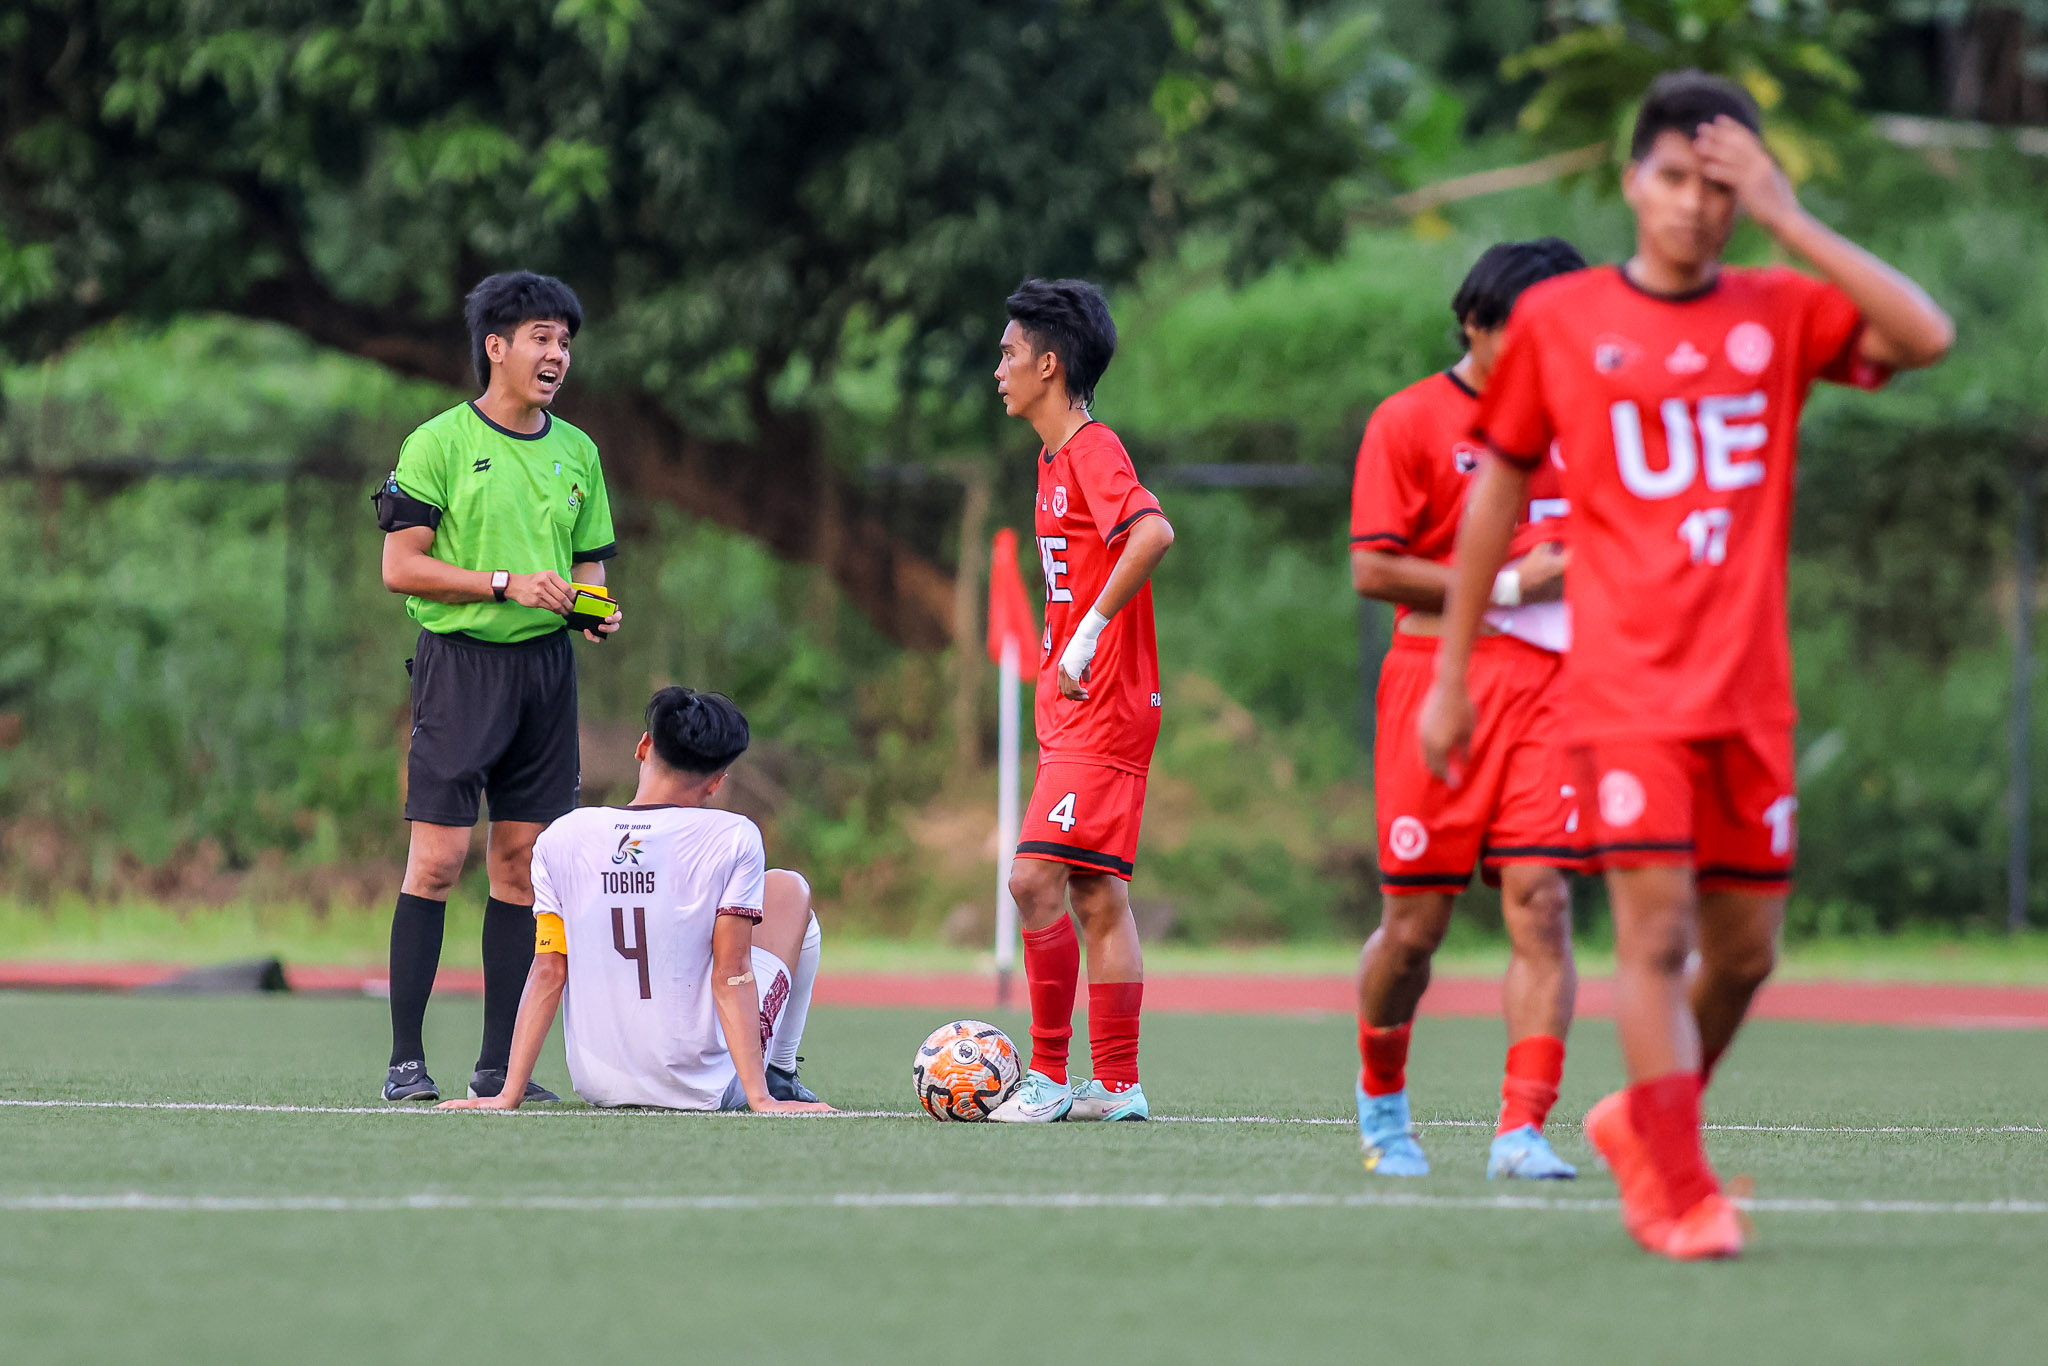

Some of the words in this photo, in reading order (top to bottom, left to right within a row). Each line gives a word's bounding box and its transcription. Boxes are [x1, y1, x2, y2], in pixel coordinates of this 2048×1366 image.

[1610, 391, 1768, 500] UE
[1676, 506, 1733, 566] 17
[1047, 791, 1077, 833] 4
[600, 871, 655, 894] TOBIAS
[610, 907, 652, 999] 4
